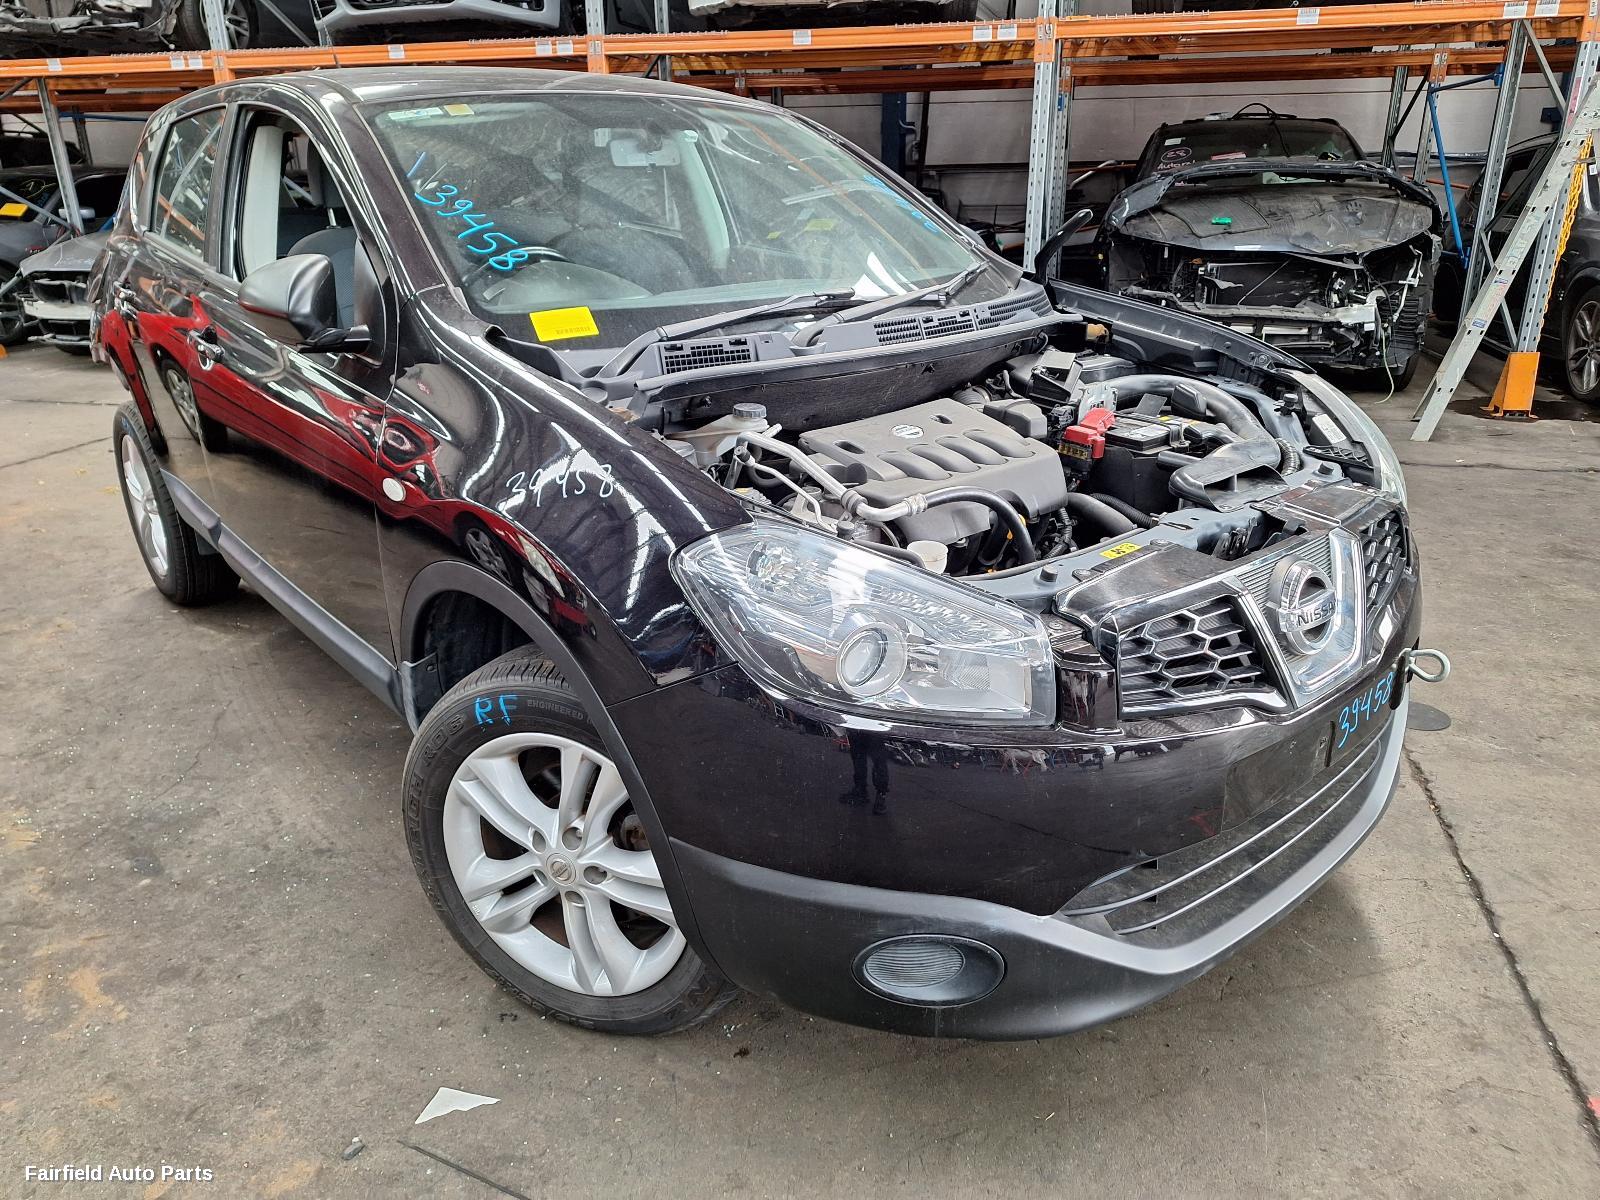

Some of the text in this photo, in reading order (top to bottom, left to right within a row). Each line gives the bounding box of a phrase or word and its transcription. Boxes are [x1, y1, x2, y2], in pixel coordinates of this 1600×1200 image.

[414, 184, 529, 271] 39458
[505, 463, 614, 508] 39458
[1297, 599, 1336, 627] NISSA
[474, 694, 518, 726] RF
[1337, 671, 1395, 749] 39458
